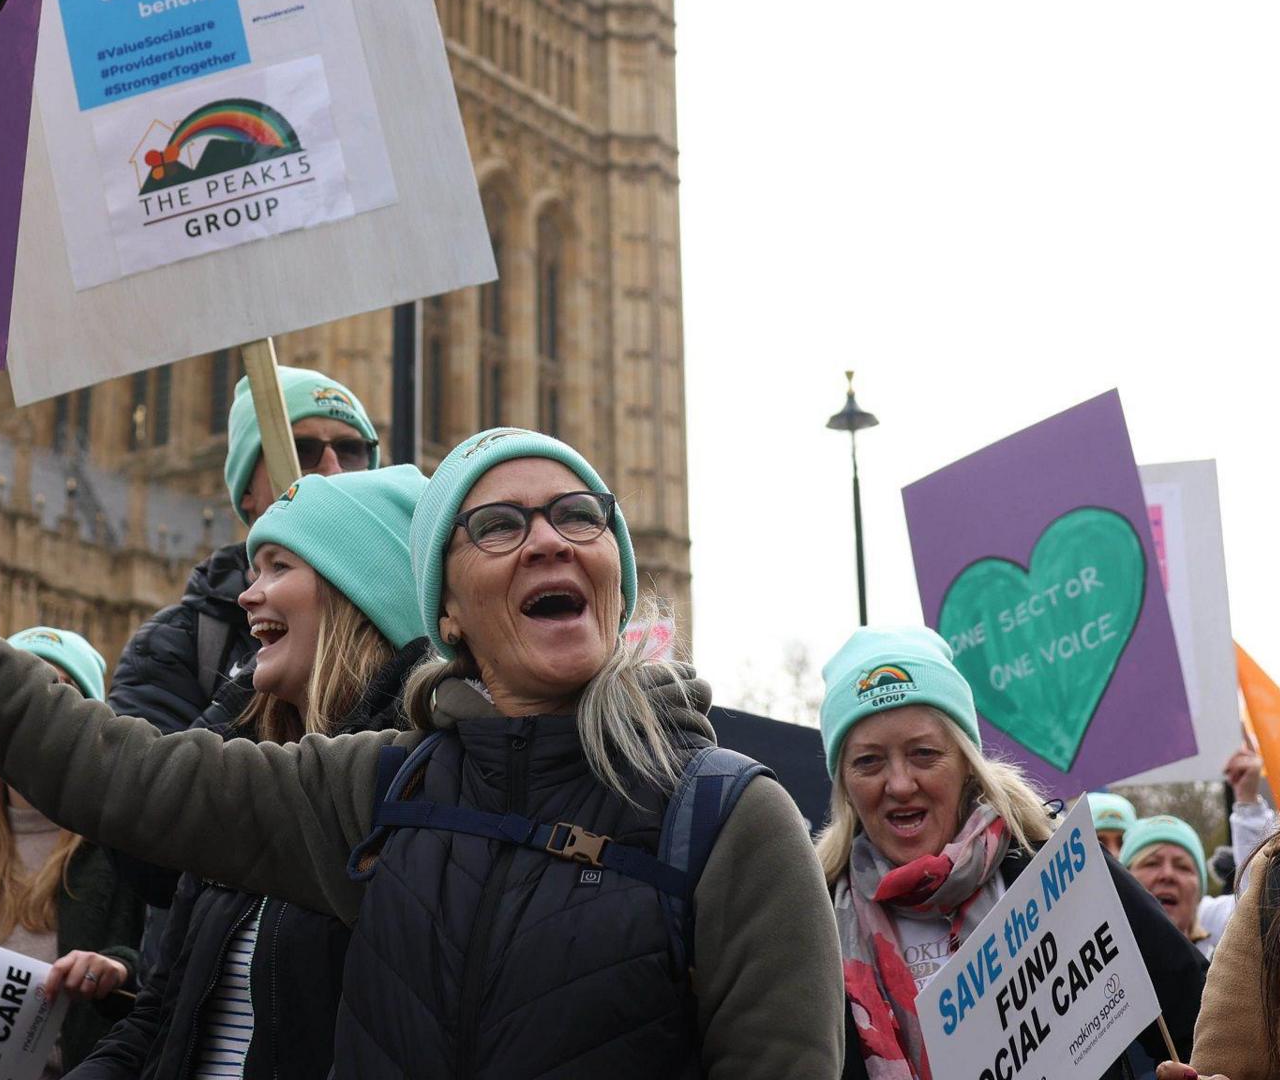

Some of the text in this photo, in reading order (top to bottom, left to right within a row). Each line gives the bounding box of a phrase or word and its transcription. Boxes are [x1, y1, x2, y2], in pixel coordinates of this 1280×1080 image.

[97, 20, 215, 61] #ValueSocialcare
[101, 39, 212, 79] #ProvidersUnite
[104, 51, 237, 97] #StrongerTogether
[140, 186, 191, 216] THE
[185, 197, 279, 238] GROUP
[948, 566, 1104, 657] ONE SECTOR
[989, 613, 1117, 691] ONE VOICE
[872, 693, 906, 707] GROUP
[939, 827, 1086, 1036] SAVE the NHS
[979, 921, 1119, 1080] CIAL CARE
[995, 931, 1058, 1032] FUND
[1069, 989, 1125, 1055] making space
